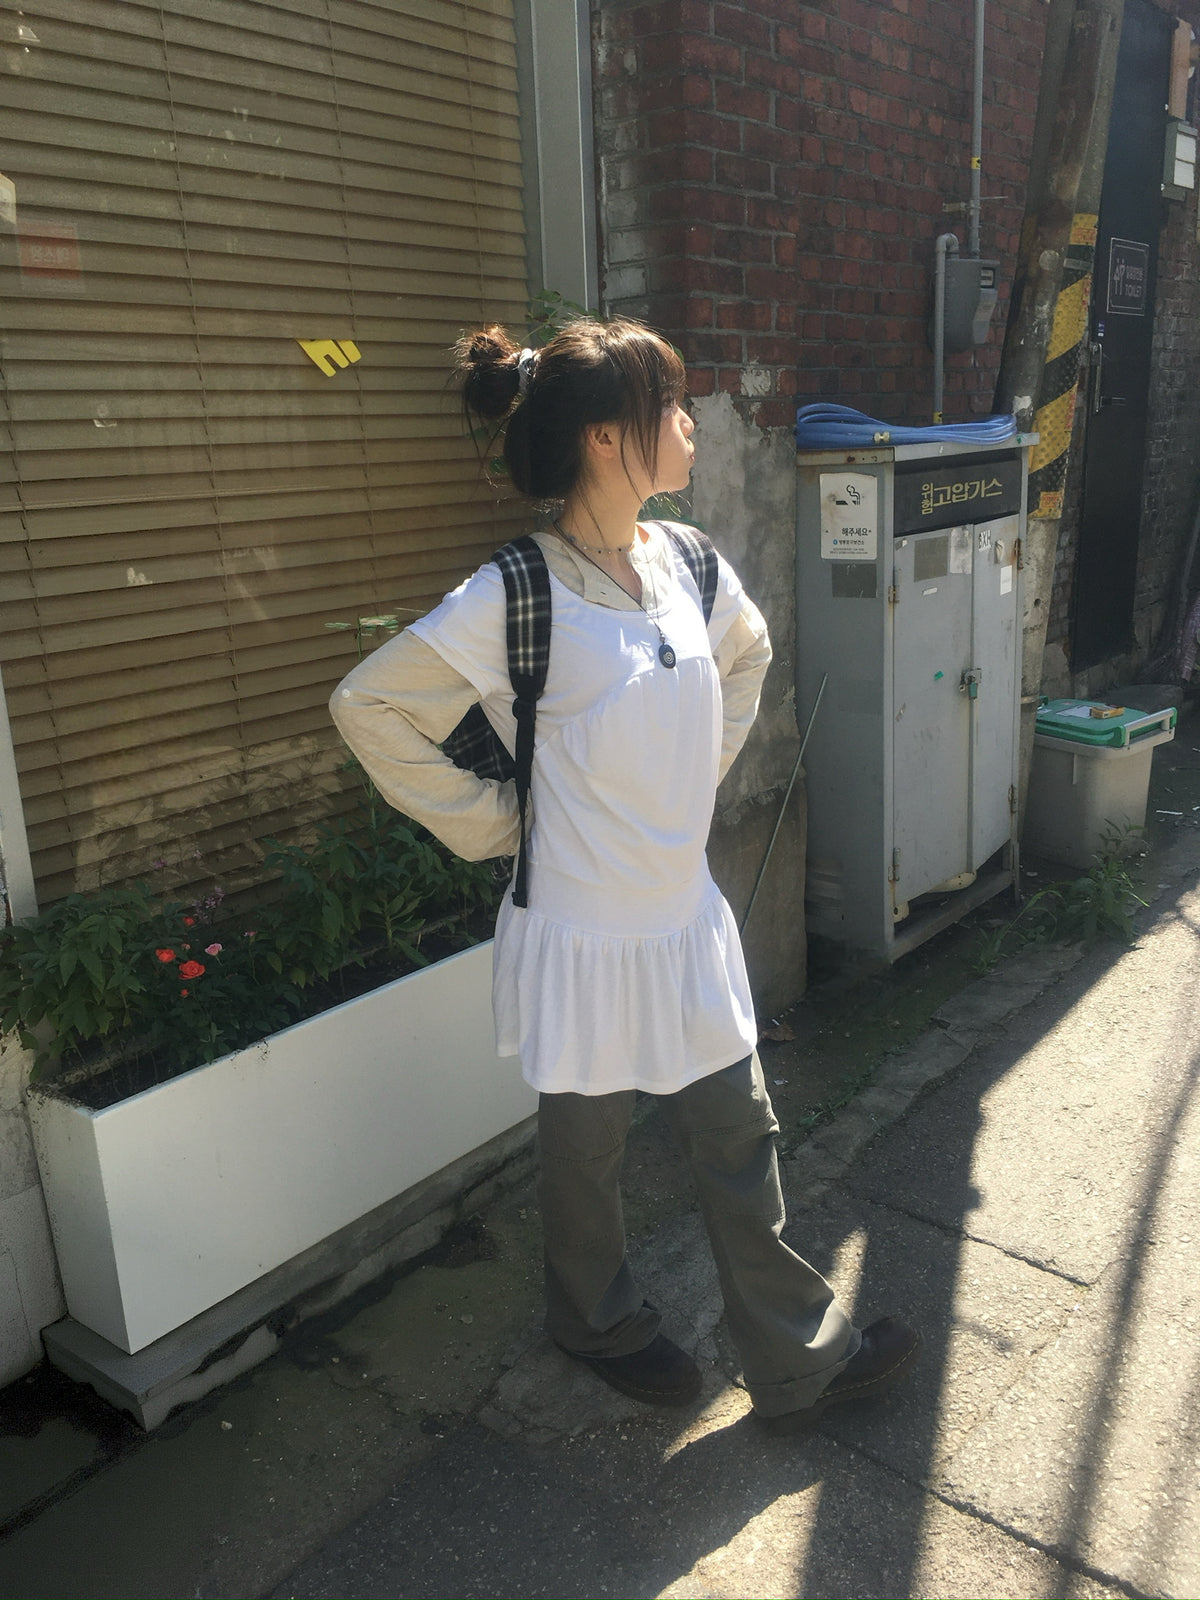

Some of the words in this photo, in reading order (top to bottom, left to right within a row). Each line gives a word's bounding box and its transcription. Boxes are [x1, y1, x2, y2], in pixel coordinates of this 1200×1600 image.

[1125, 283, 1142, 297] TOILET
[921, 482, 934, 515] 위험
[933, 478, 1003, 507] 고압가스
